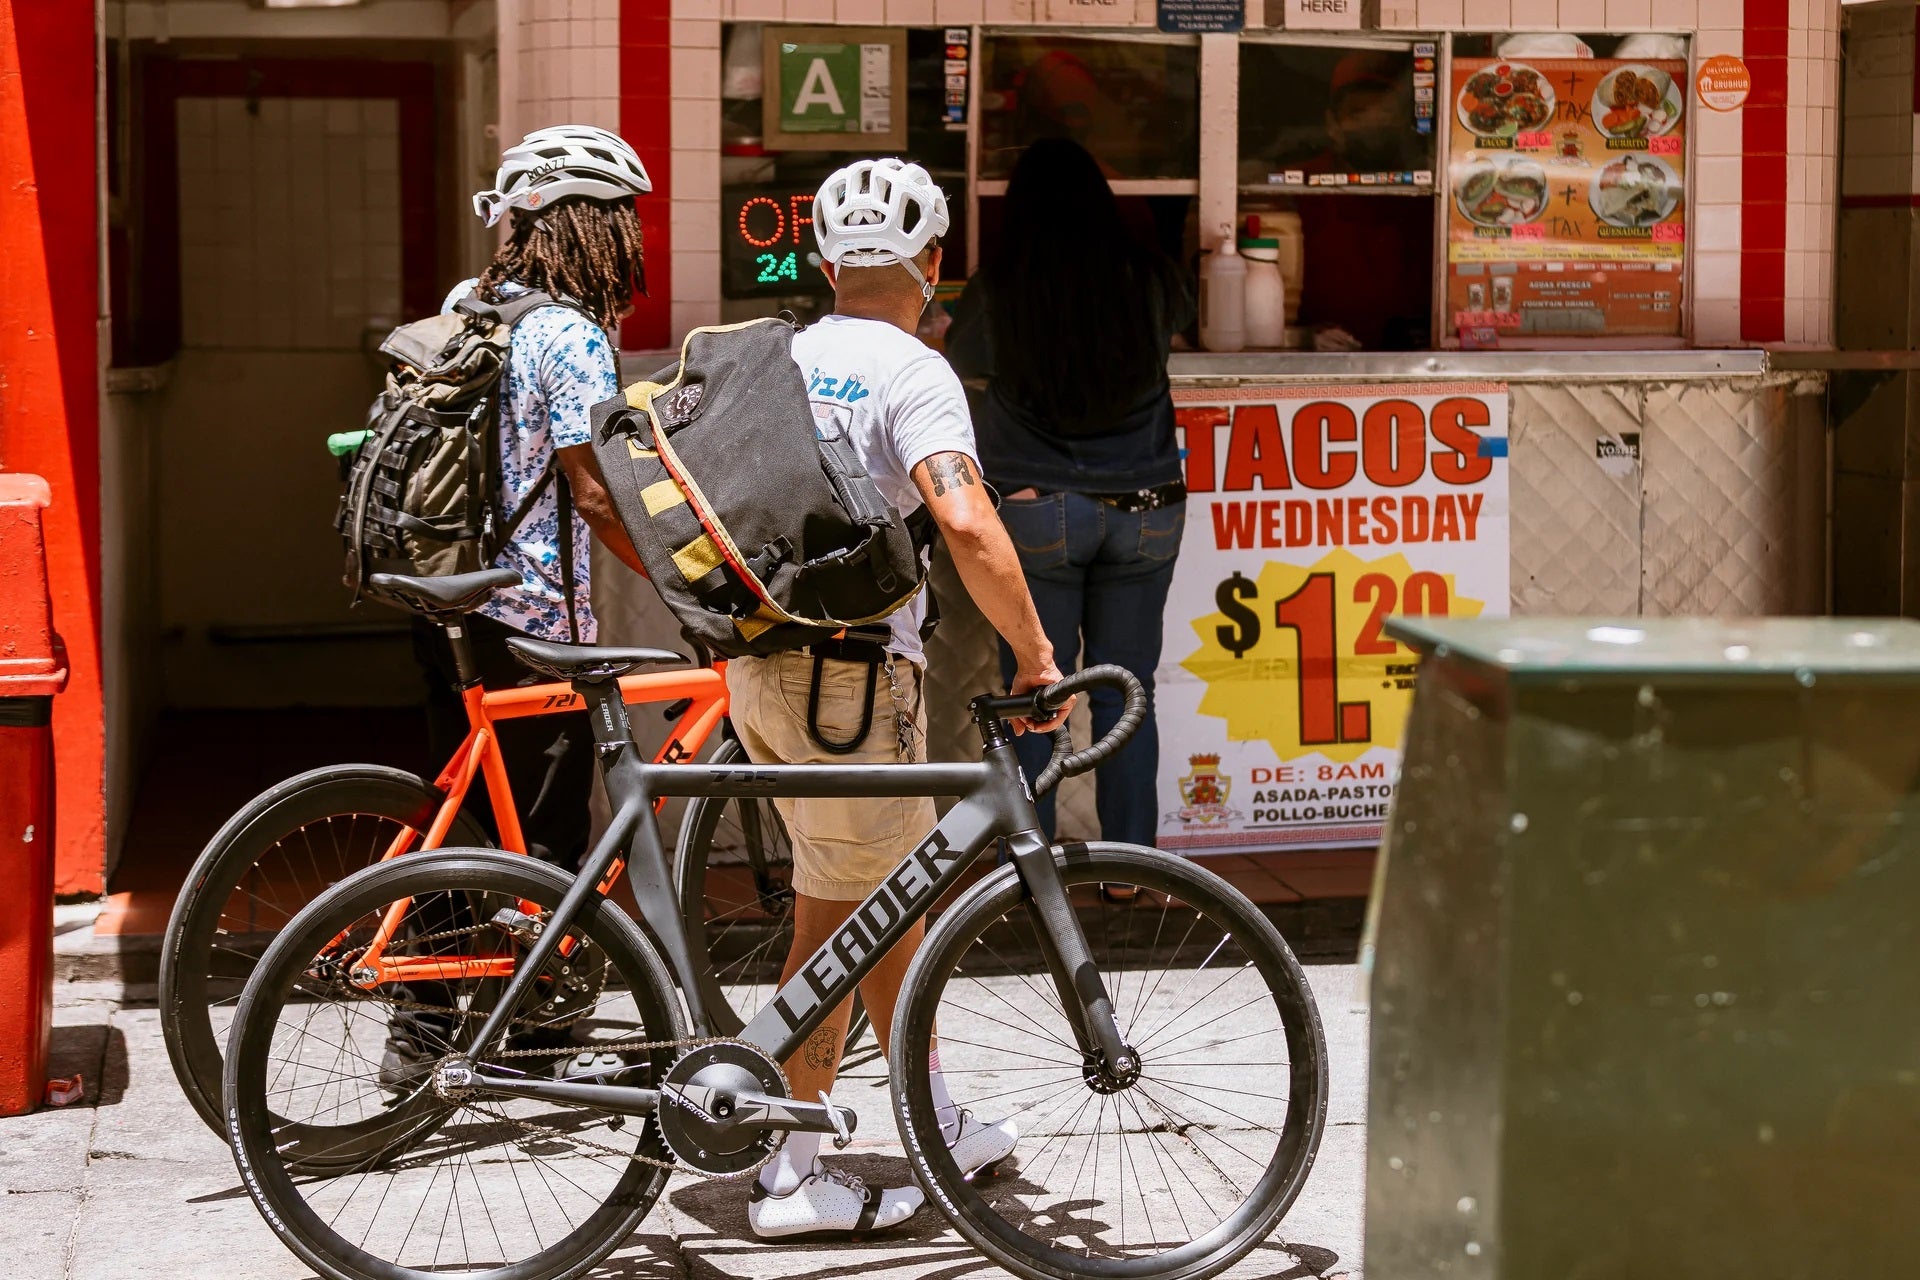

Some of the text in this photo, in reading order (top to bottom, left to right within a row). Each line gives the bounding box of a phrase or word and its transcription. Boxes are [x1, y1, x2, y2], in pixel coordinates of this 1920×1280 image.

[791, 57, 845, 115] A
[1555, 101, 1592, 121] TAX
[1609, 138, 1647, 147] BURRITO
[1599, 227, 1652, 237] QUESADILLA
[756, 251, 798, 282] 24
[1175, 397, 1493, 493] TACOS
[1210, 493, 1484, 551] WEDNESDAY
[543, 693, 578, 709] 721
[599, 697, 614, 732] LEADER
[1251, 763, 1385, 784] DE: 8AM
[1253, 803, 1390, 822] POLLO-BUCHE
[772, 828, 963, 1034] LEADER
[233, 1135, 249, 1168] EAGLE
[905, 1119, 921, 1152] EAGLE
[245, 1169, 285, 1233] GOODYEAR
[918, 1156, 959, 1217] GOODYEAR
